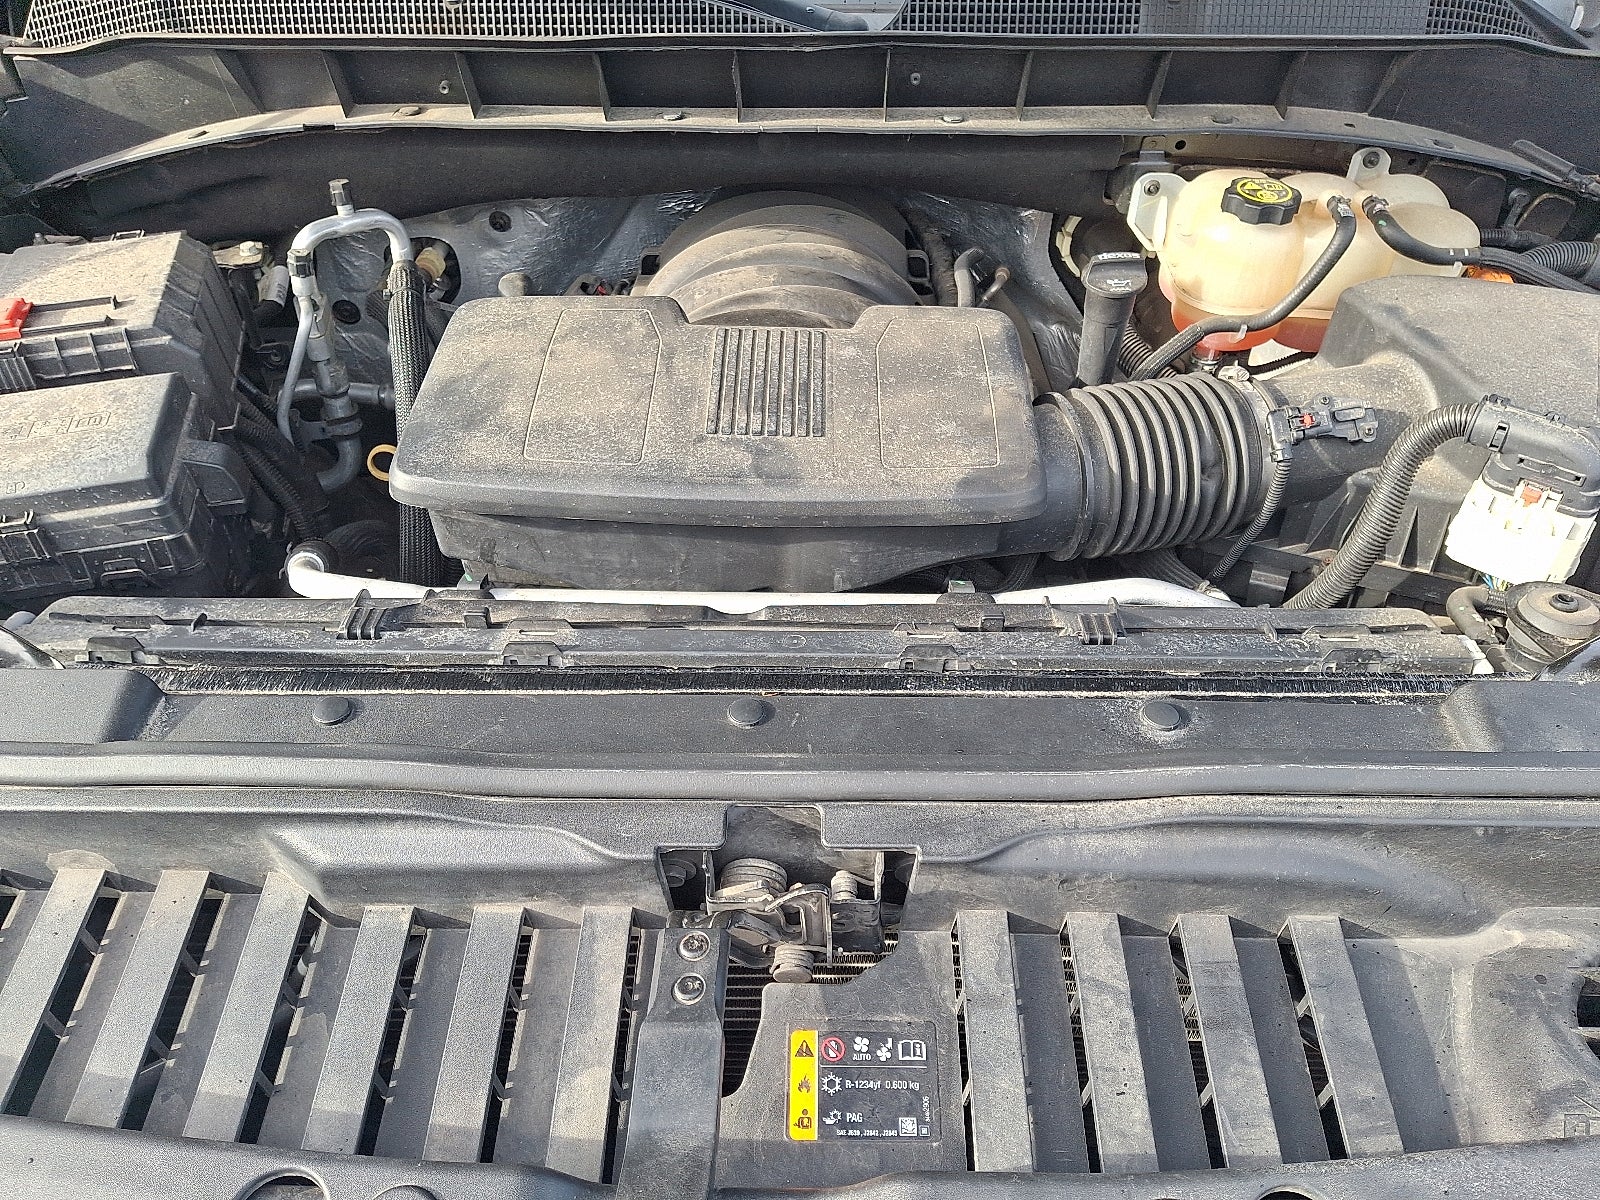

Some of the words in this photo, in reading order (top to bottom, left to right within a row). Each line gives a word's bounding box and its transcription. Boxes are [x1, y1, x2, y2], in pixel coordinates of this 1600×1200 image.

[852, 1053, 872, 1061] AUTO
[845, 1080, 881, 1091] R-1234yf
[885, 1080, 907, 1090] 0.600
[909, 1080, 920, 1091] kg
[846, 1112, 863, 1123] PAG
